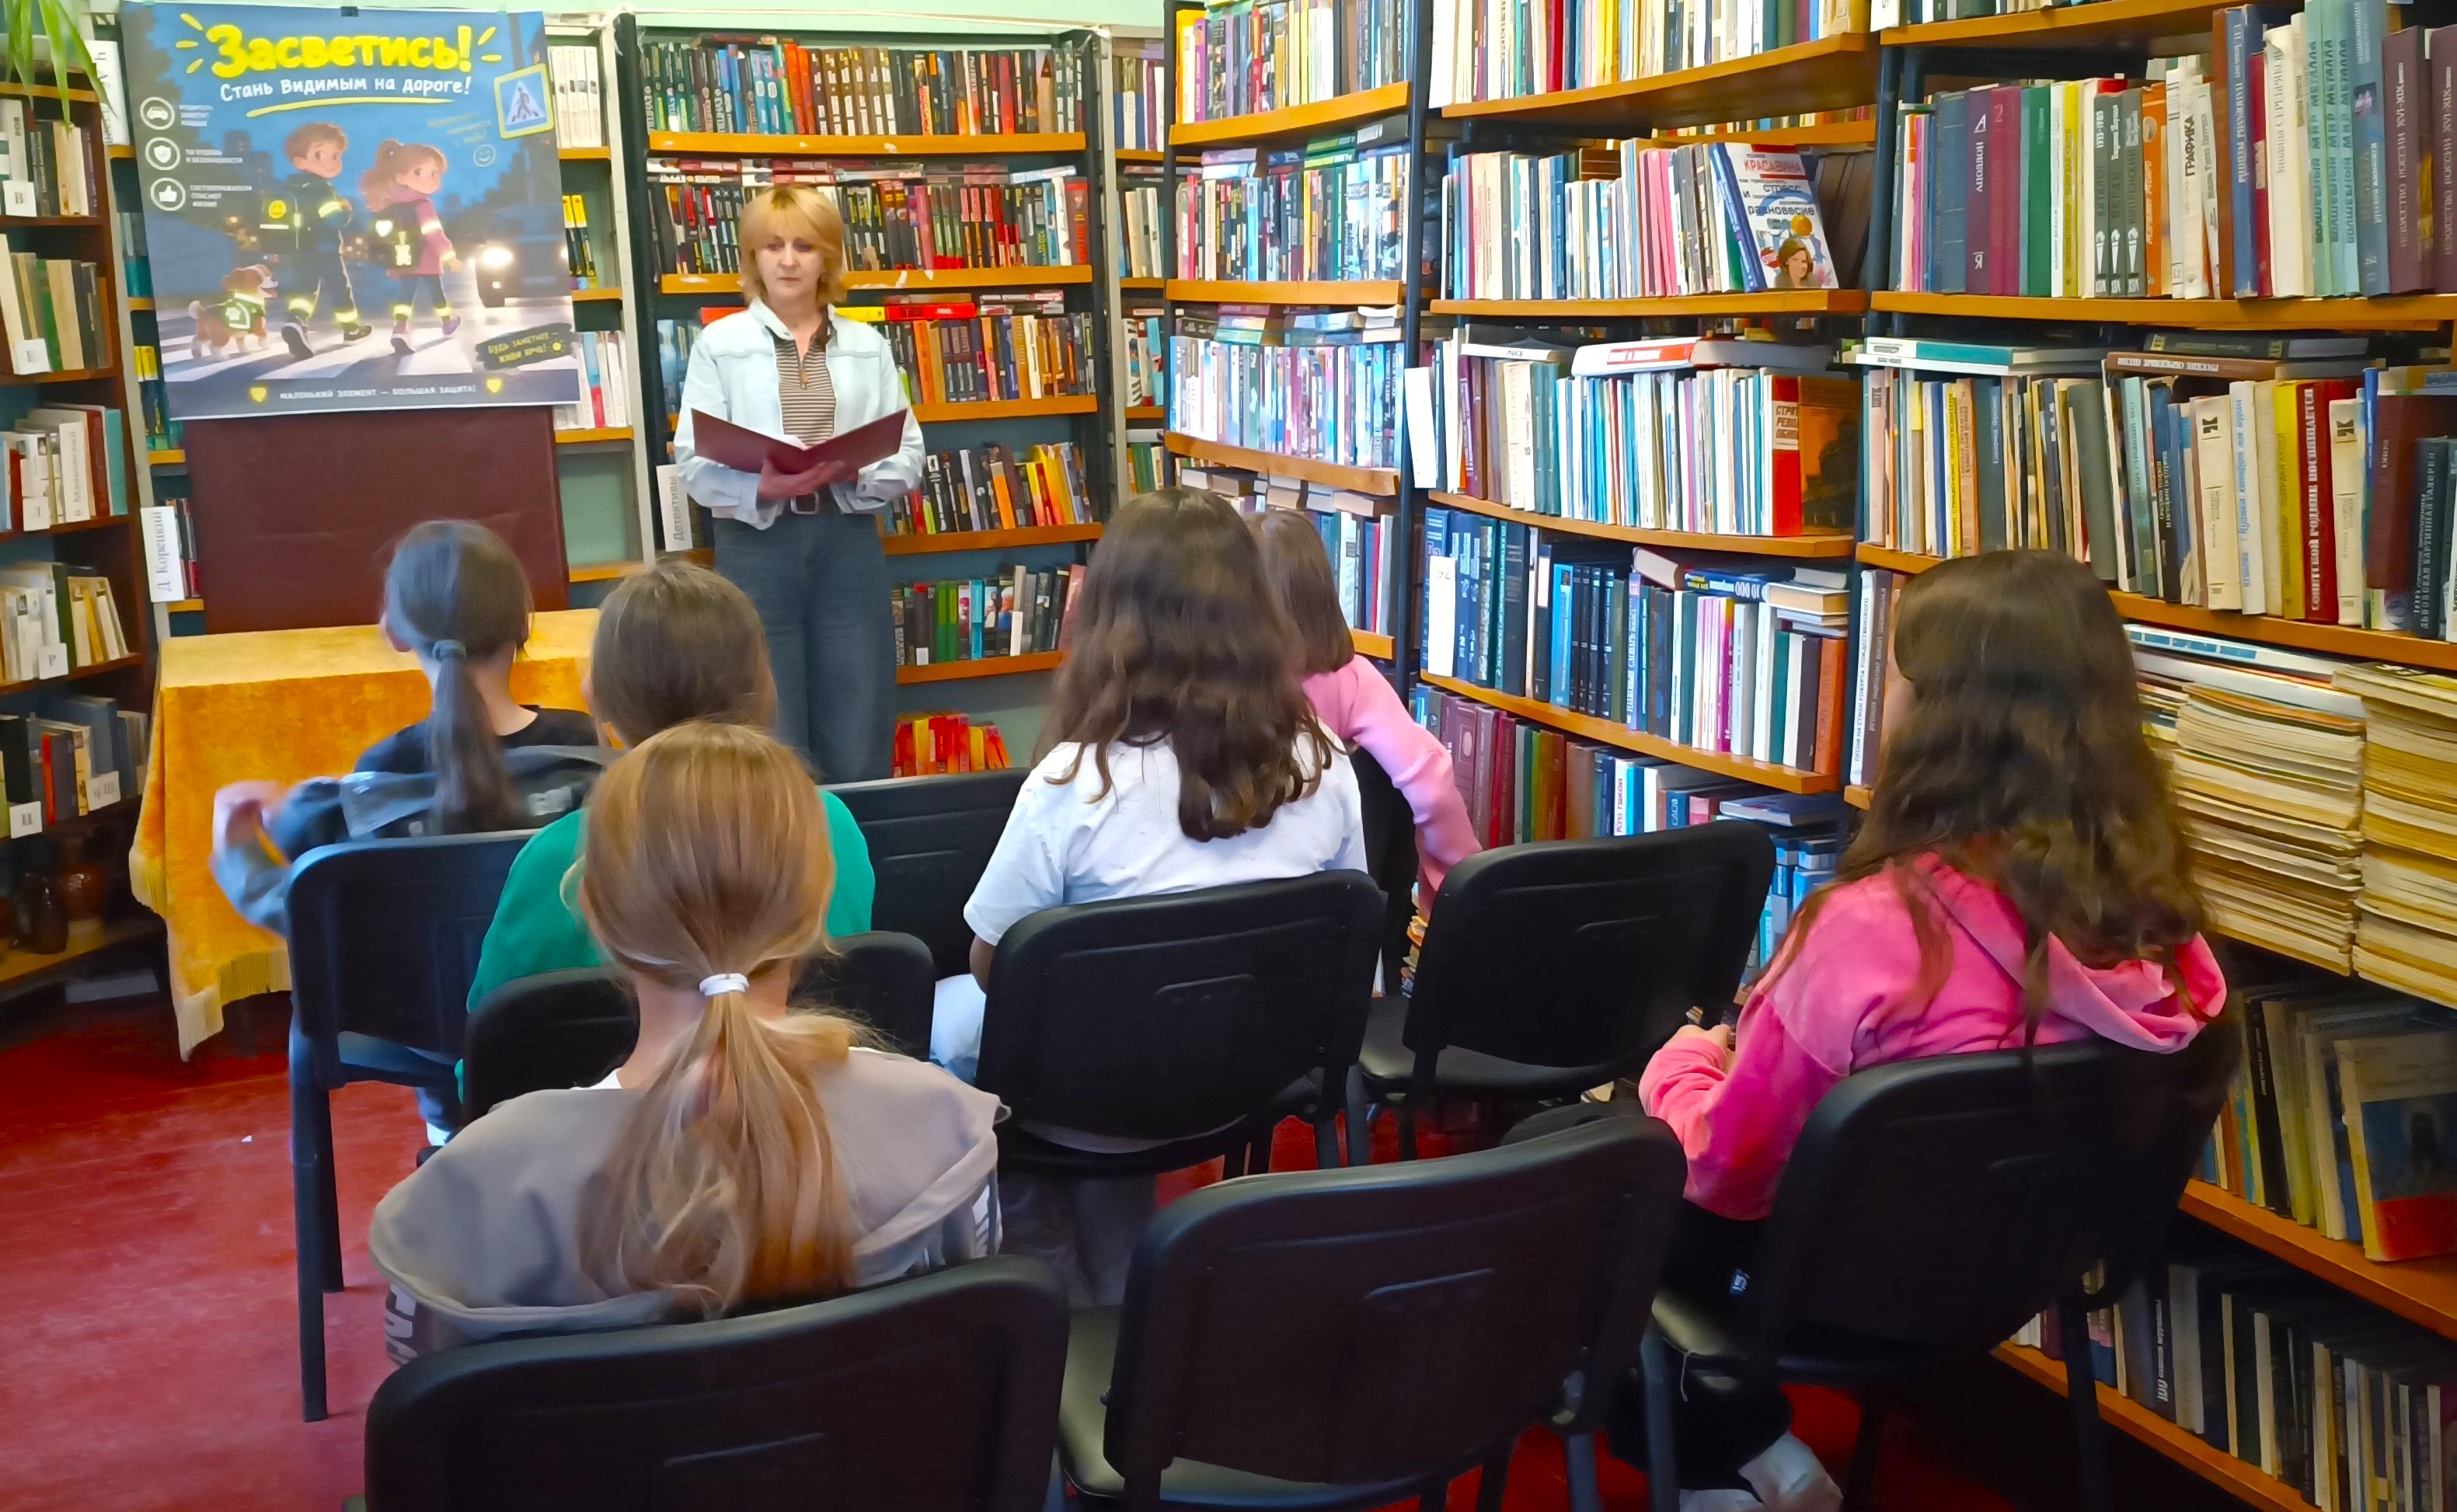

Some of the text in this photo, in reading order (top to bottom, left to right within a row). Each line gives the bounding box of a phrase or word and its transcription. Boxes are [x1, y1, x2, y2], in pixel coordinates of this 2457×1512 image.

[206, 24, 472, 78] Засветись!
[220, 84, 273, 102] Стань
[375, 78, 396, 90] на
[403, 76, 471, 96] дороге!
[2273, 50, 2284, 127] СЕРЕБРЯКОВ
[2183, 114, 2195, 177] ГРАФИКА
[280, 390, 333, 399] МАЛЕНЬКИЙ
[337, 388, 376, 397] ЭЛЕМЕНТ
[392, 387, 435, 395] БОЛЬШАЯ
[668, 476, 685, 542] Детективы
[2305, 388, 2321, 611] СОВЕТСКОЙ РОДИНЕ ПОСВЯЩАЕТСЯ
[152, 510, 169, 573] Корецкий
